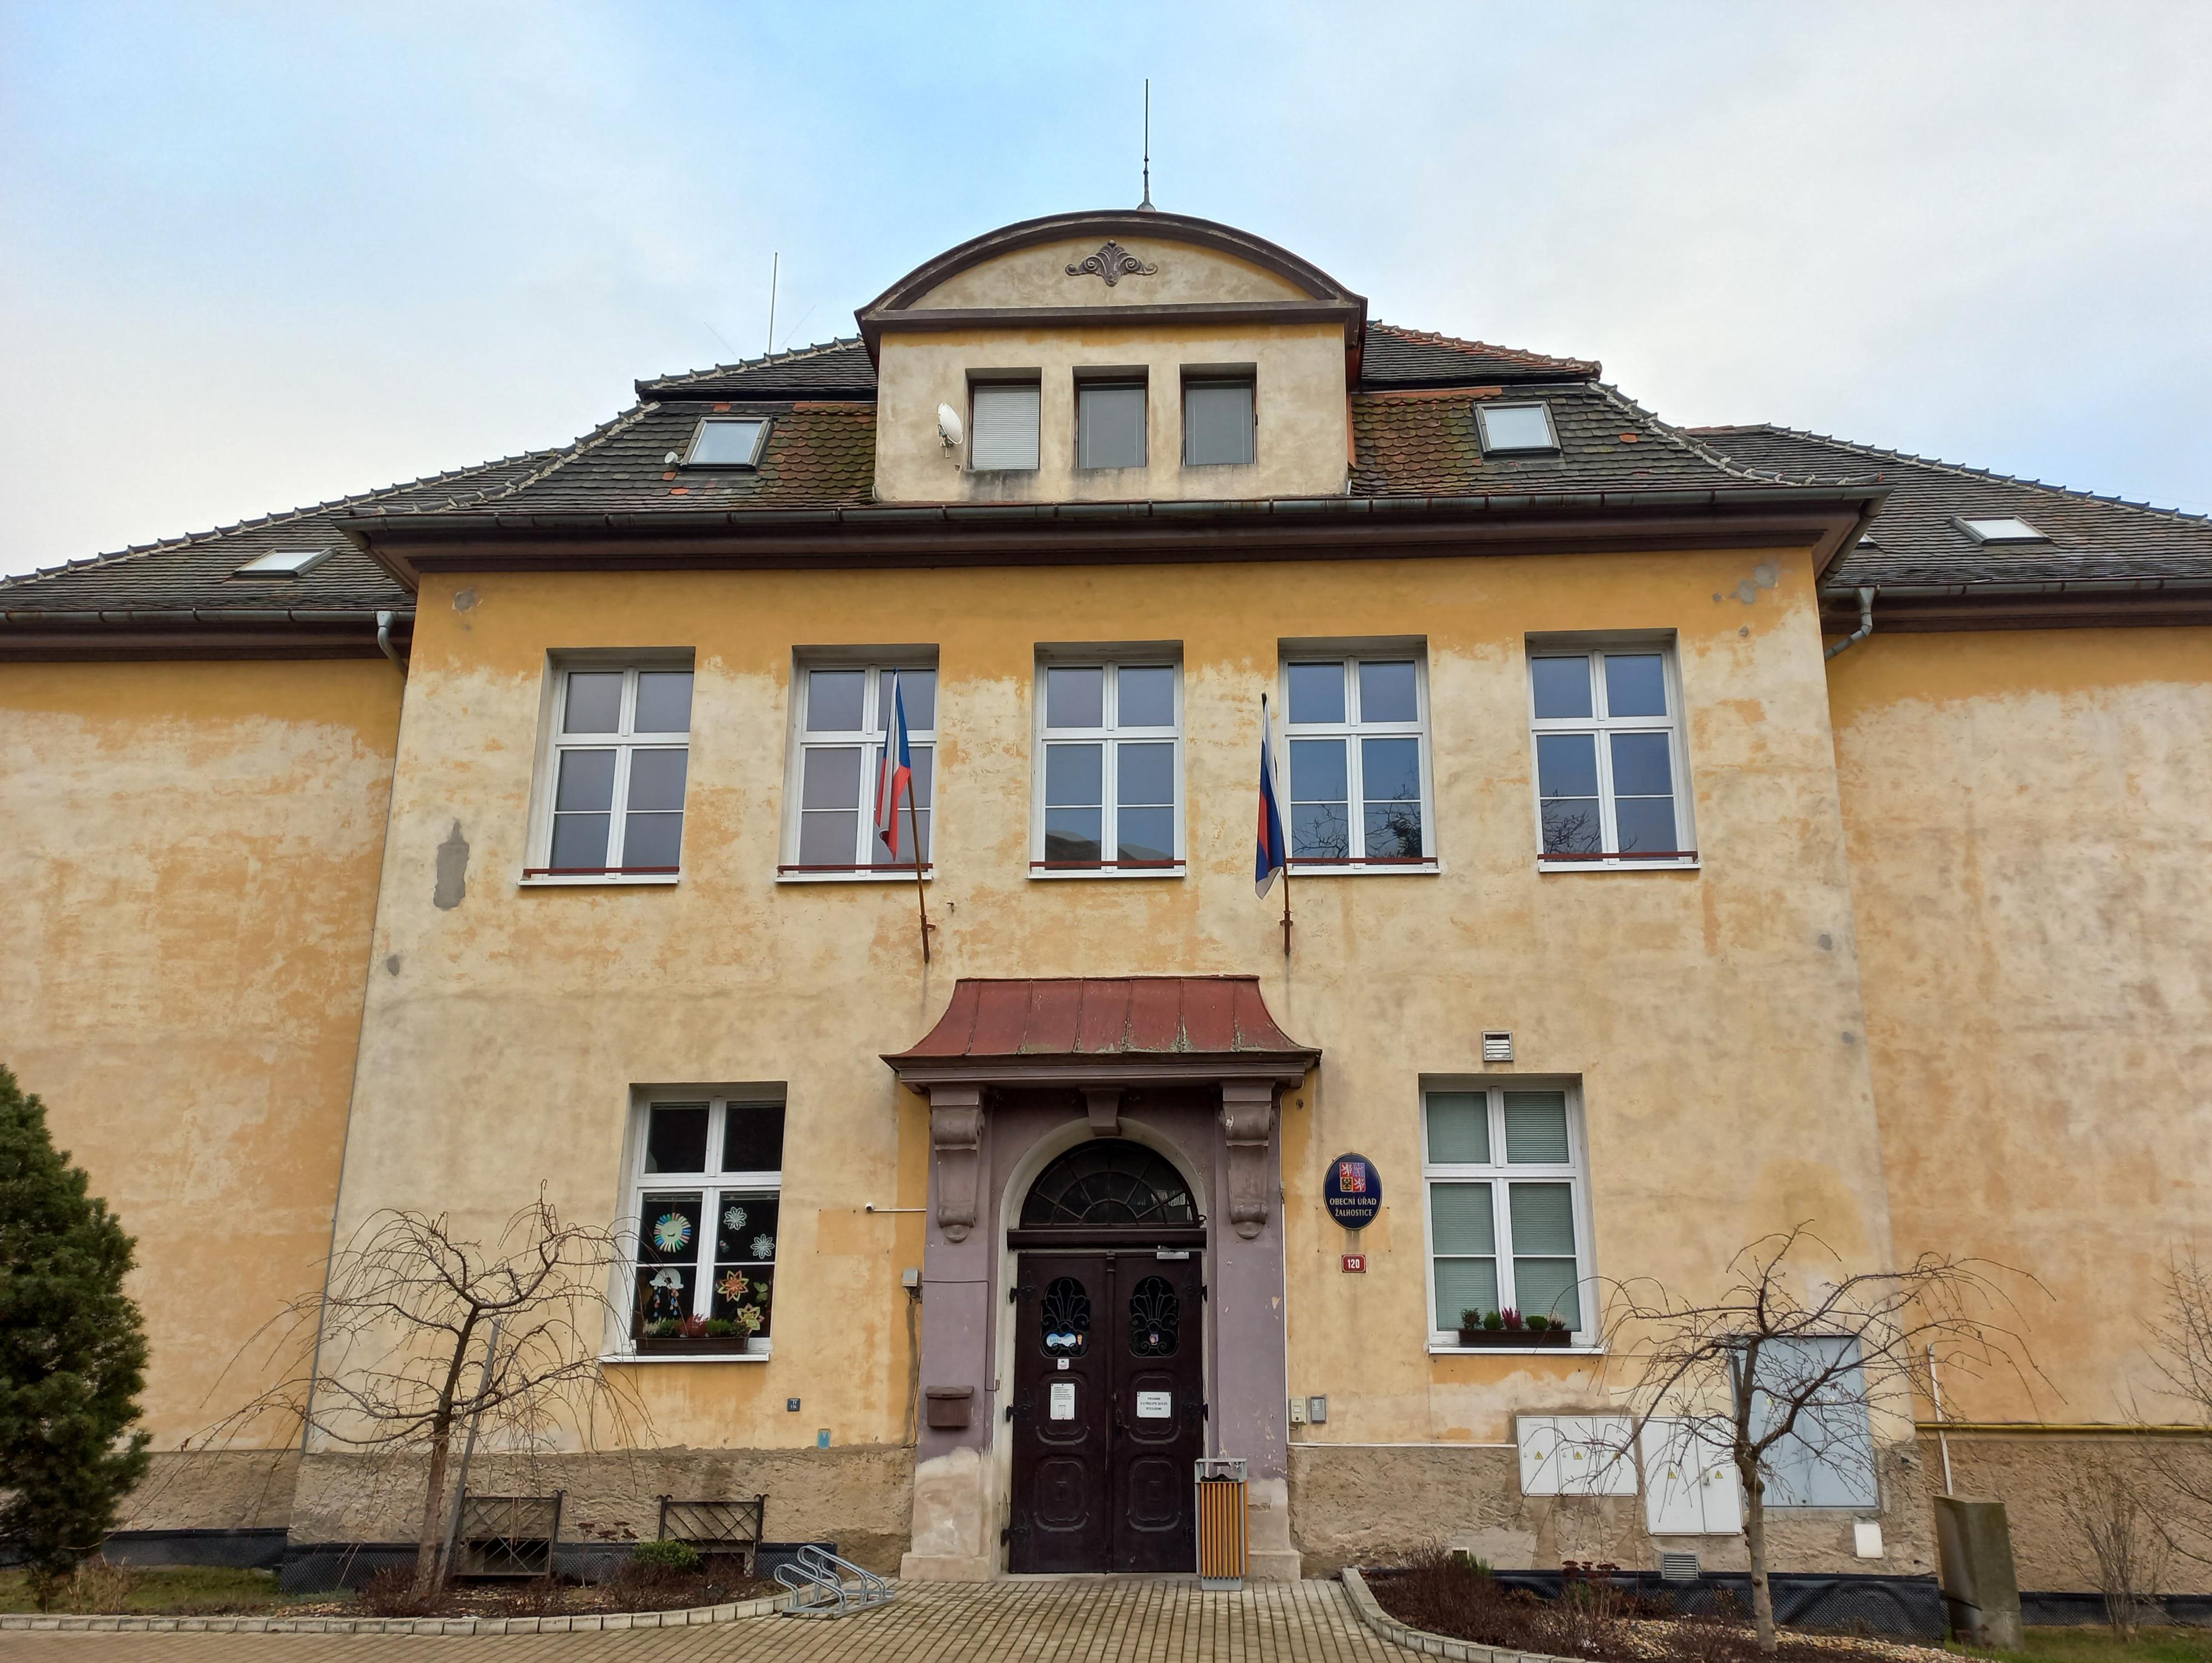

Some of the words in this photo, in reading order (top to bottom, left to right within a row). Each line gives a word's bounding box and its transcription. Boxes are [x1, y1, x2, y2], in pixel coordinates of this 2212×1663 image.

[1329, 1196, 1355, 1205] OBECNÍ
[1357, 1196, 1377, 1205] ÚŘAD
[1335, 1207, 1373, 1216] ŽALHOSTICE
[1347, 1259, 1360, 1269] 120
